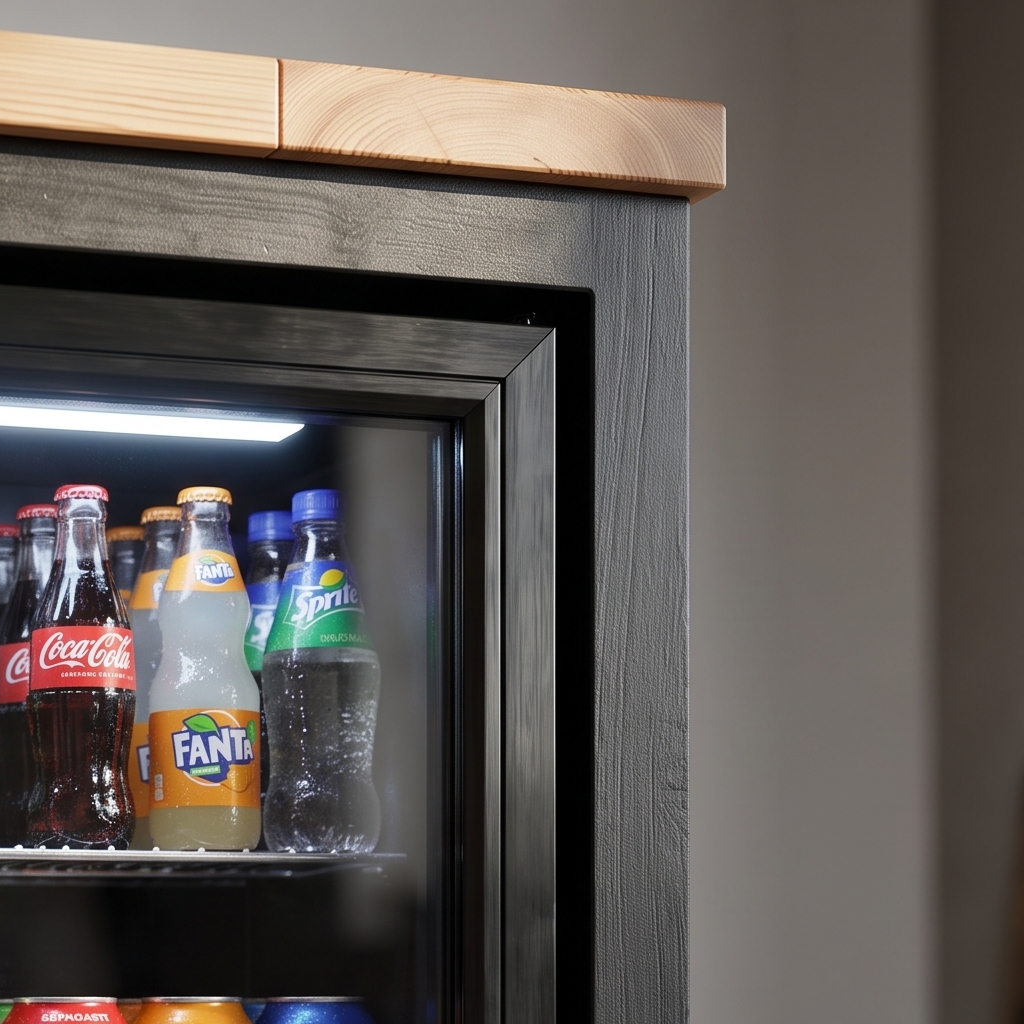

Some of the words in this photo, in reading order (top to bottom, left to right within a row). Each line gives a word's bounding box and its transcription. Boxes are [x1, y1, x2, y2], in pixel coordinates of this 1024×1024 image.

[291, 582, 359, 622] Sprite
[39, 632, 132, 669] Coca-Cola
[173, 728, 254, 768] FANTA
